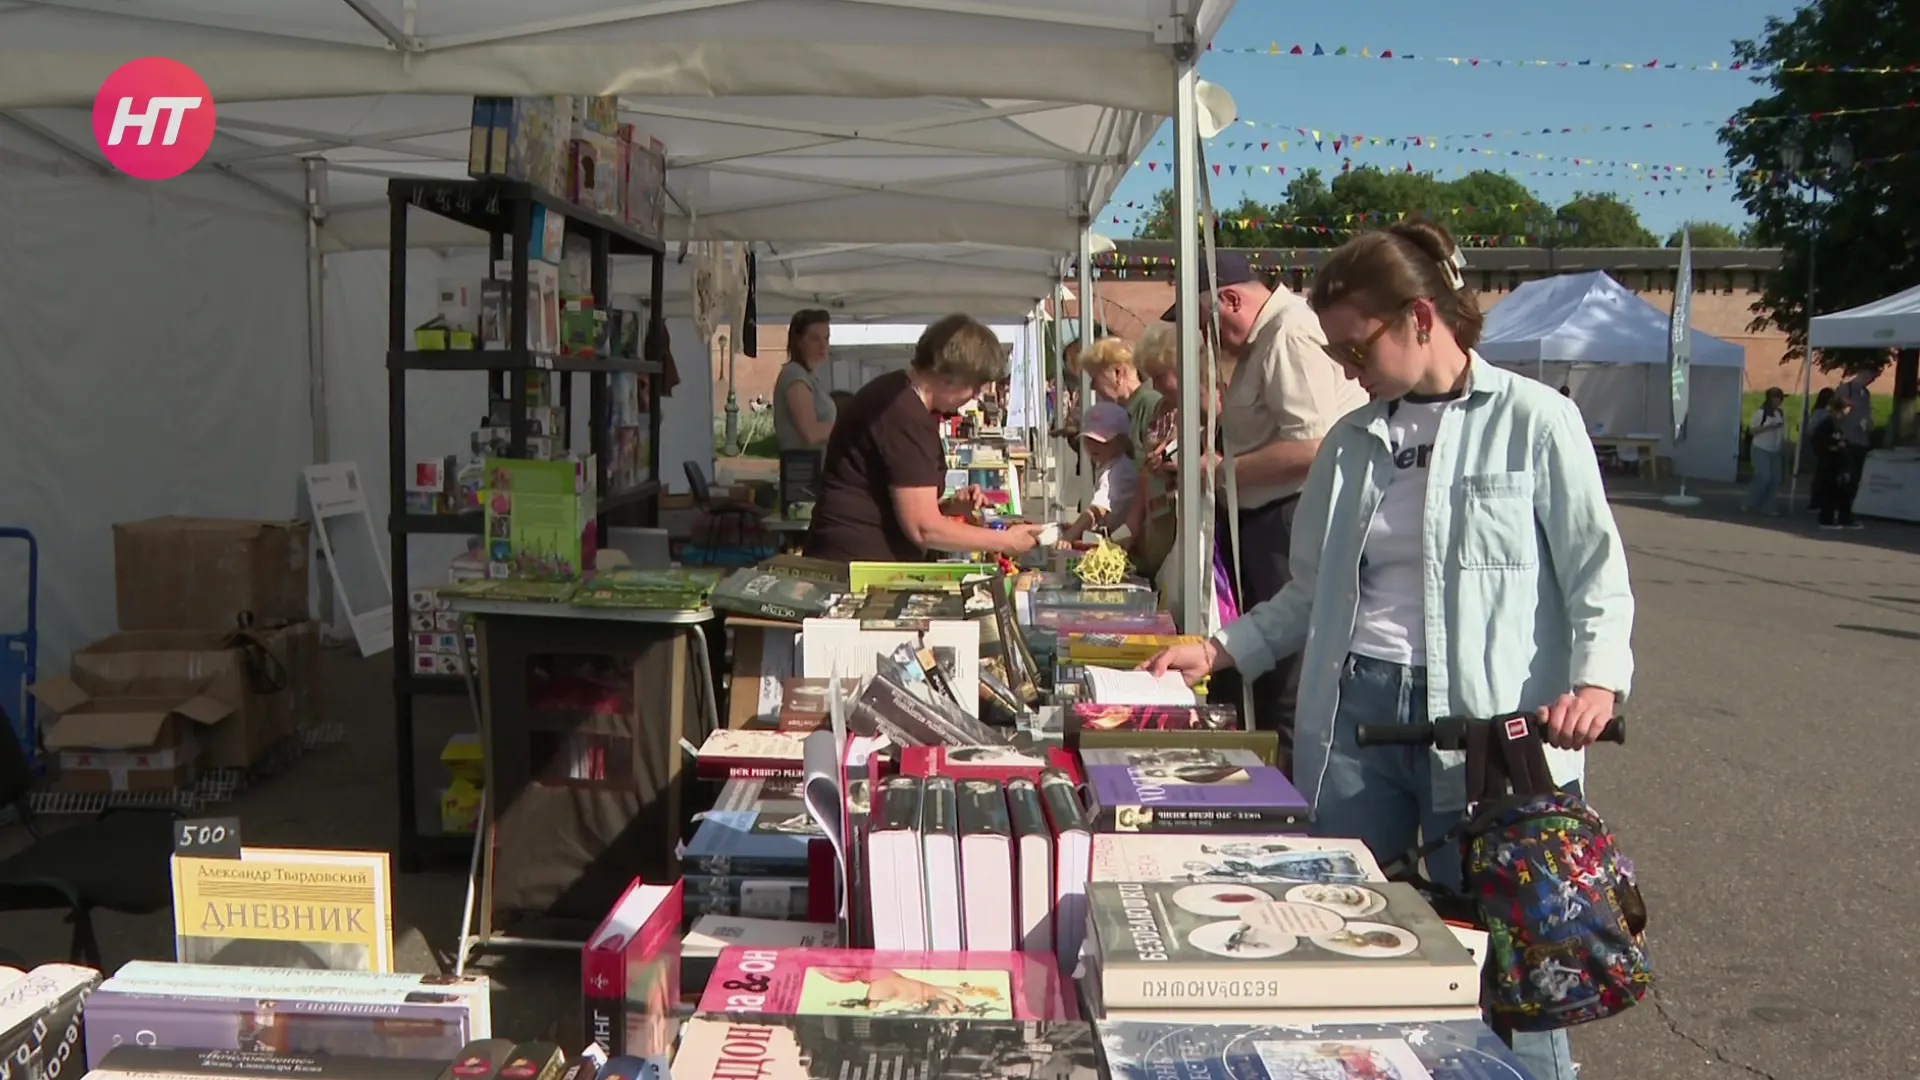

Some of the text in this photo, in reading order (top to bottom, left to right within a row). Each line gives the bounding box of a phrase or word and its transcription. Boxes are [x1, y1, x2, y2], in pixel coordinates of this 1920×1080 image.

[197, 864, 367, 885] Александр Твардовский
[201, 901, 368, 934] ДНЕВНИК
[593, 1009, 611, 1056] ИНГ
